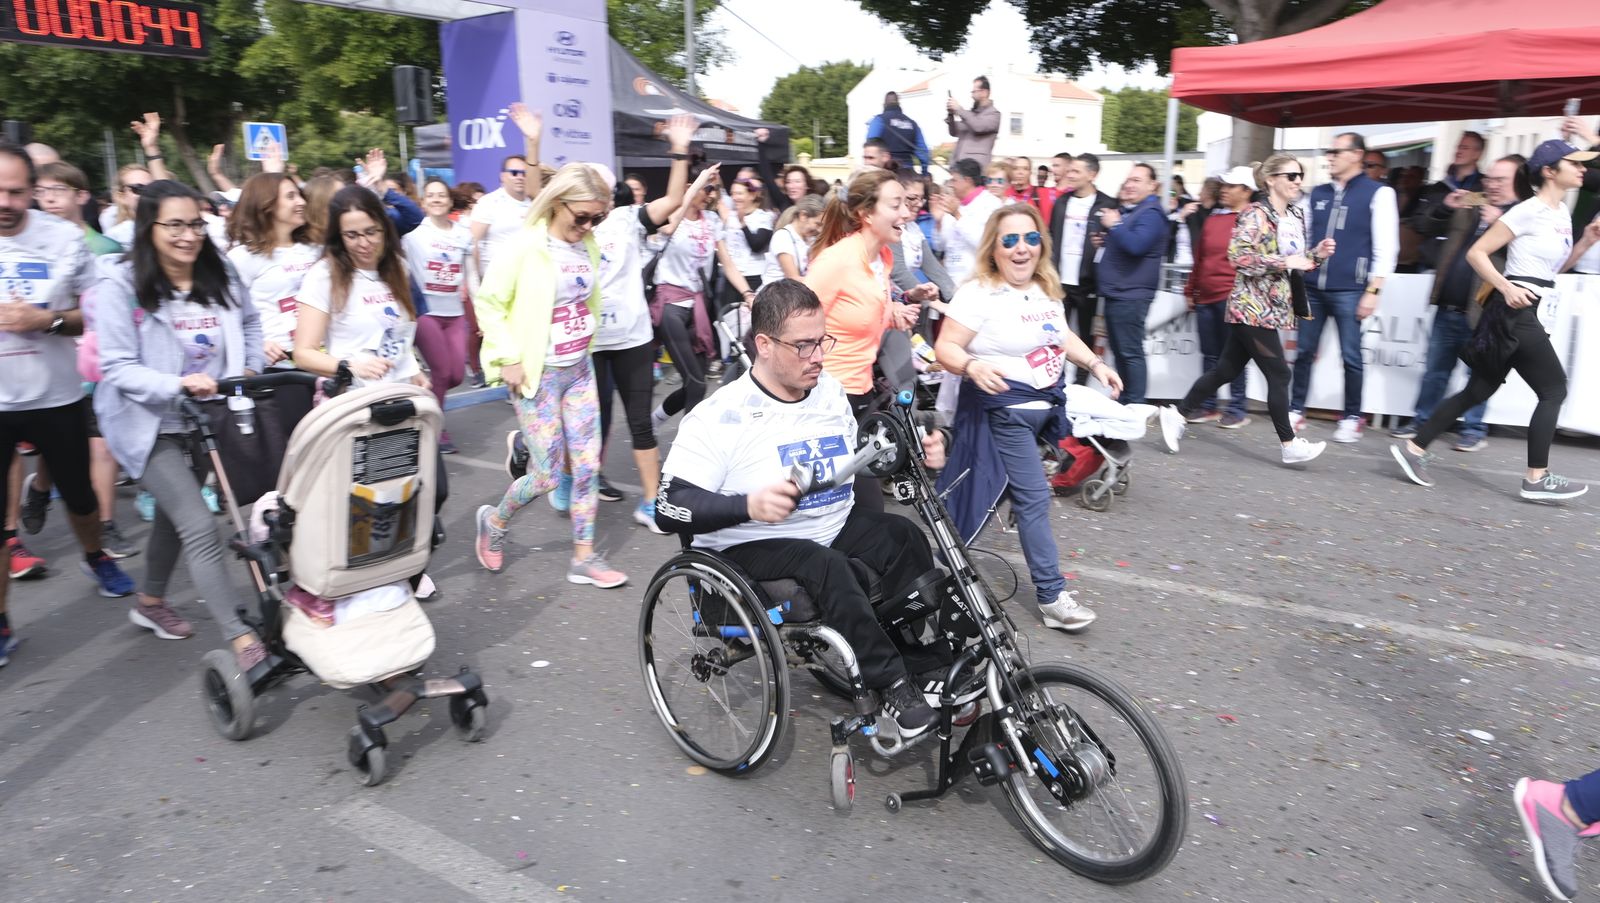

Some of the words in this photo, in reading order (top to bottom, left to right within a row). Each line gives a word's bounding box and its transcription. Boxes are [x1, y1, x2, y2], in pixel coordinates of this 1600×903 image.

[1021, 310, 1058, 323] MUJER
[564, 317, 586, 335] 545
[804, 458, 836, 481] 91
